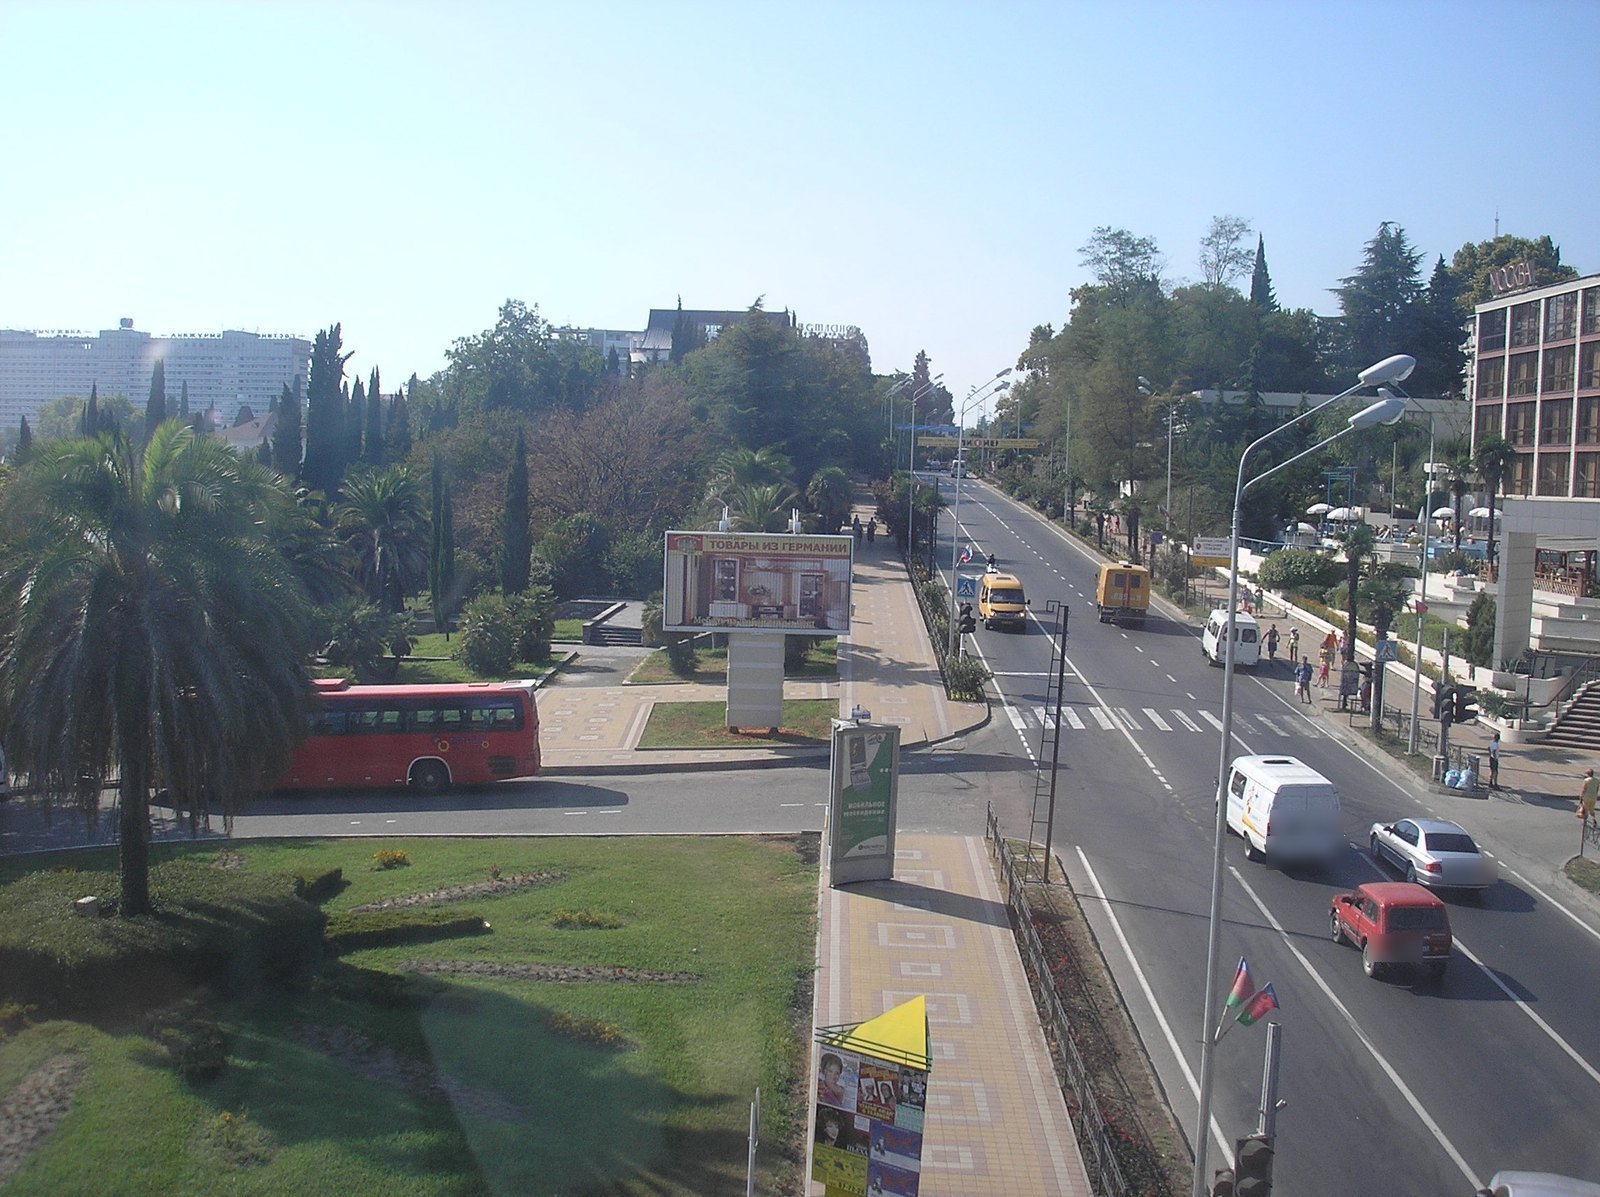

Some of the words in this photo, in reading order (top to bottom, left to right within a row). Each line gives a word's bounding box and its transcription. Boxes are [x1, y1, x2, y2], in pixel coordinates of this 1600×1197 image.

[709, 540, 759, 550] ТОВАРЫ
[762, 542, 779, 550] ИЗ
[782, 543, 847, 553] ГЕРМАНИИ
